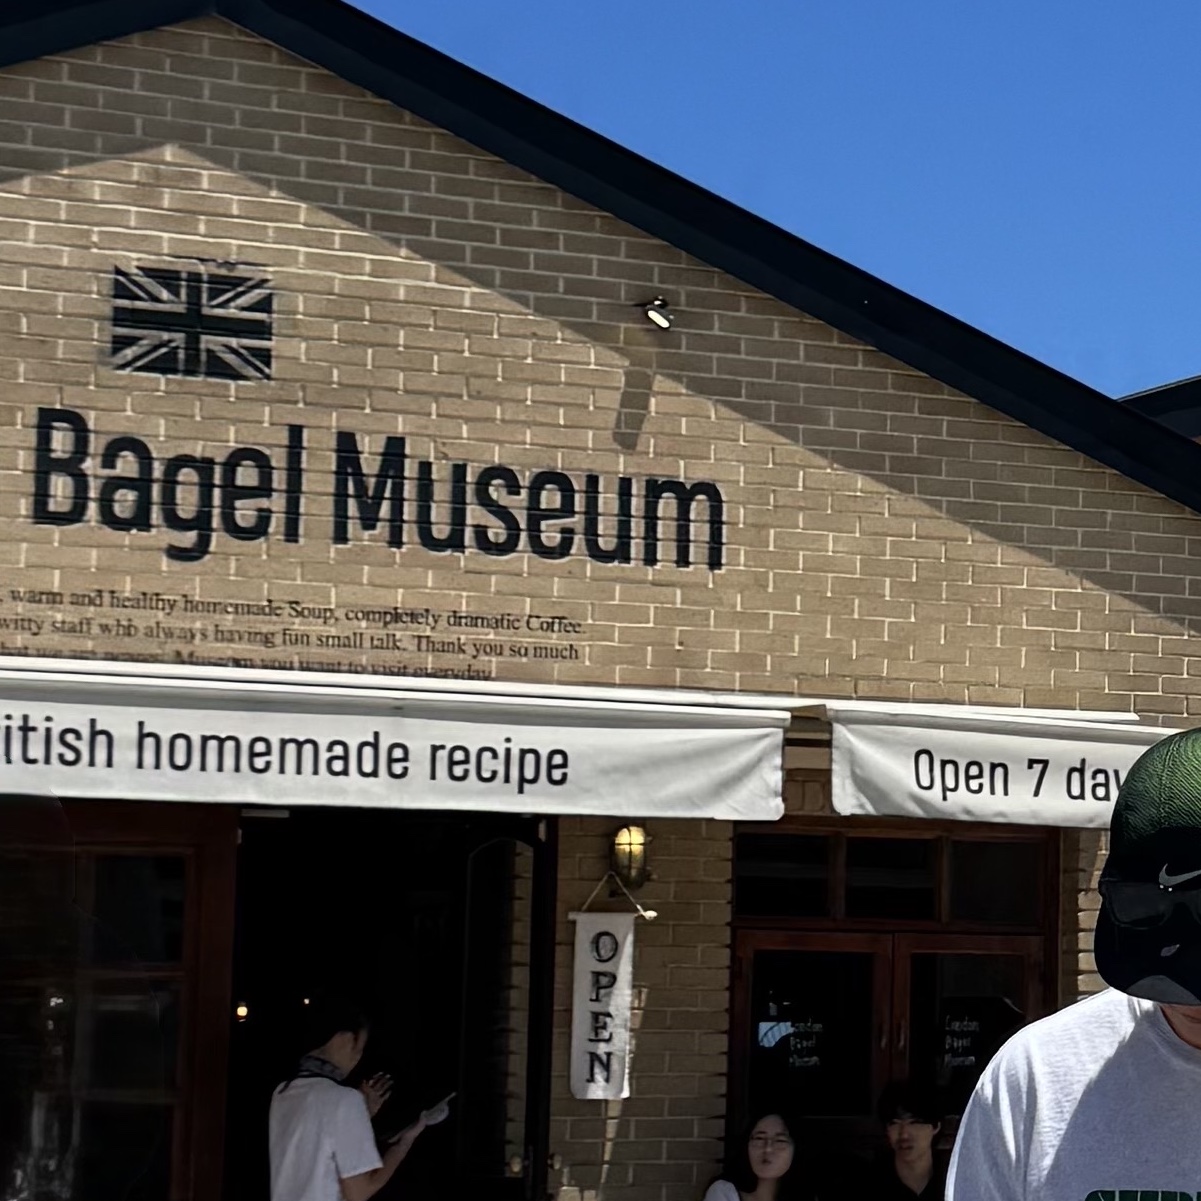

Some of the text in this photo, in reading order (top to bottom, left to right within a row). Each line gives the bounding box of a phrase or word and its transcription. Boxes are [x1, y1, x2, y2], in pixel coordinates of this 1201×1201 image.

[31, 407, 725, 570] Bagel Museum
[11, 590, 586, 633] warm and healthy homemade Soup, completely dramatic Coffee.
[51, 618, 94, 634] staff
[100, 619, 138, 637] who
[144, 621, 208, 642] always
[215, 625, 276, 647] having
[282, 629, 310, 646] fun
[316, 632, 363, 650] small
[414, 635, 465, 654] Thank
[472, 641, 503, 659] you
[509, 644, 528, 657] so
[534, 644, 578, 660] much
[0, 714, 569, 794] itish homemade recipe
[914, 749, 1009, 802] Open
[1026, 759, 1050, 798] 7
[586, 931, 619, 1084] OPEN
